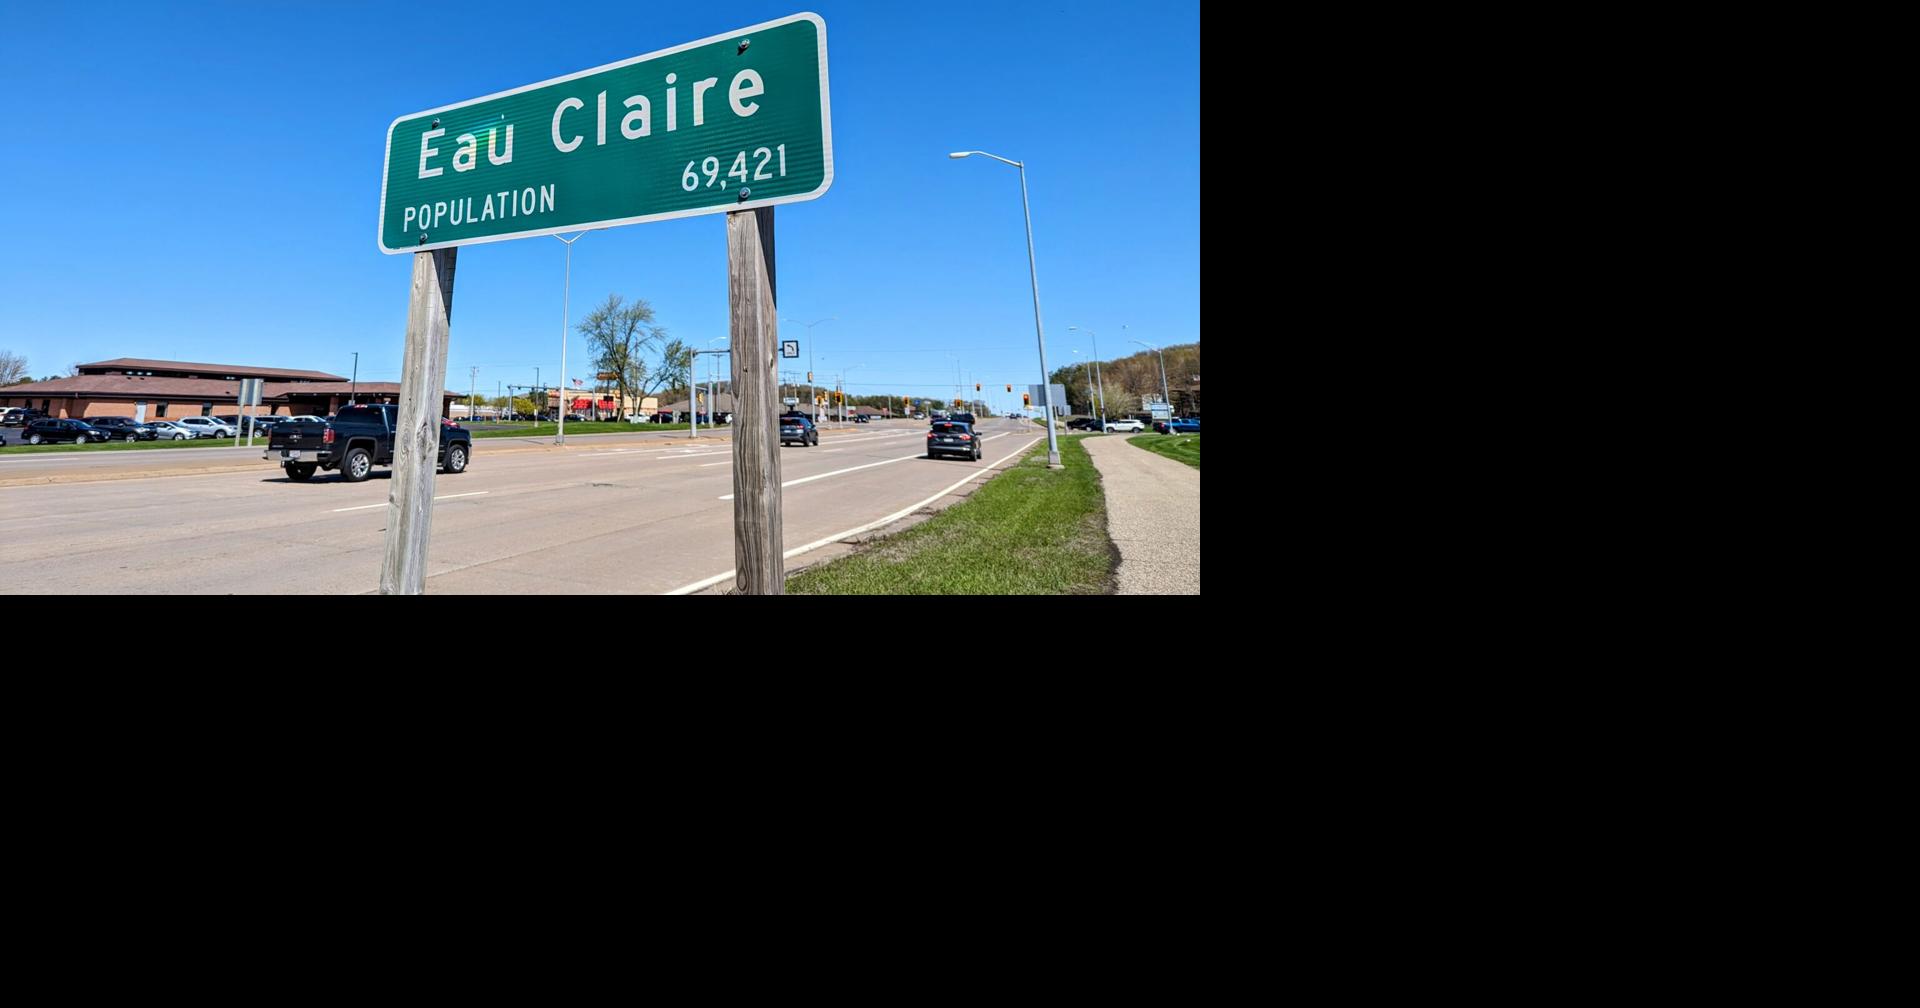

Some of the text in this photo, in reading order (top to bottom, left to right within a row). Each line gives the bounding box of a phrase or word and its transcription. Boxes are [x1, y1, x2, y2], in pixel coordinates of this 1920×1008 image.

[418, 68, 765, 179] Eau Claire
[681, 143, 787, 192] 69,421
[403, 183, 556, 233] POPULATION
